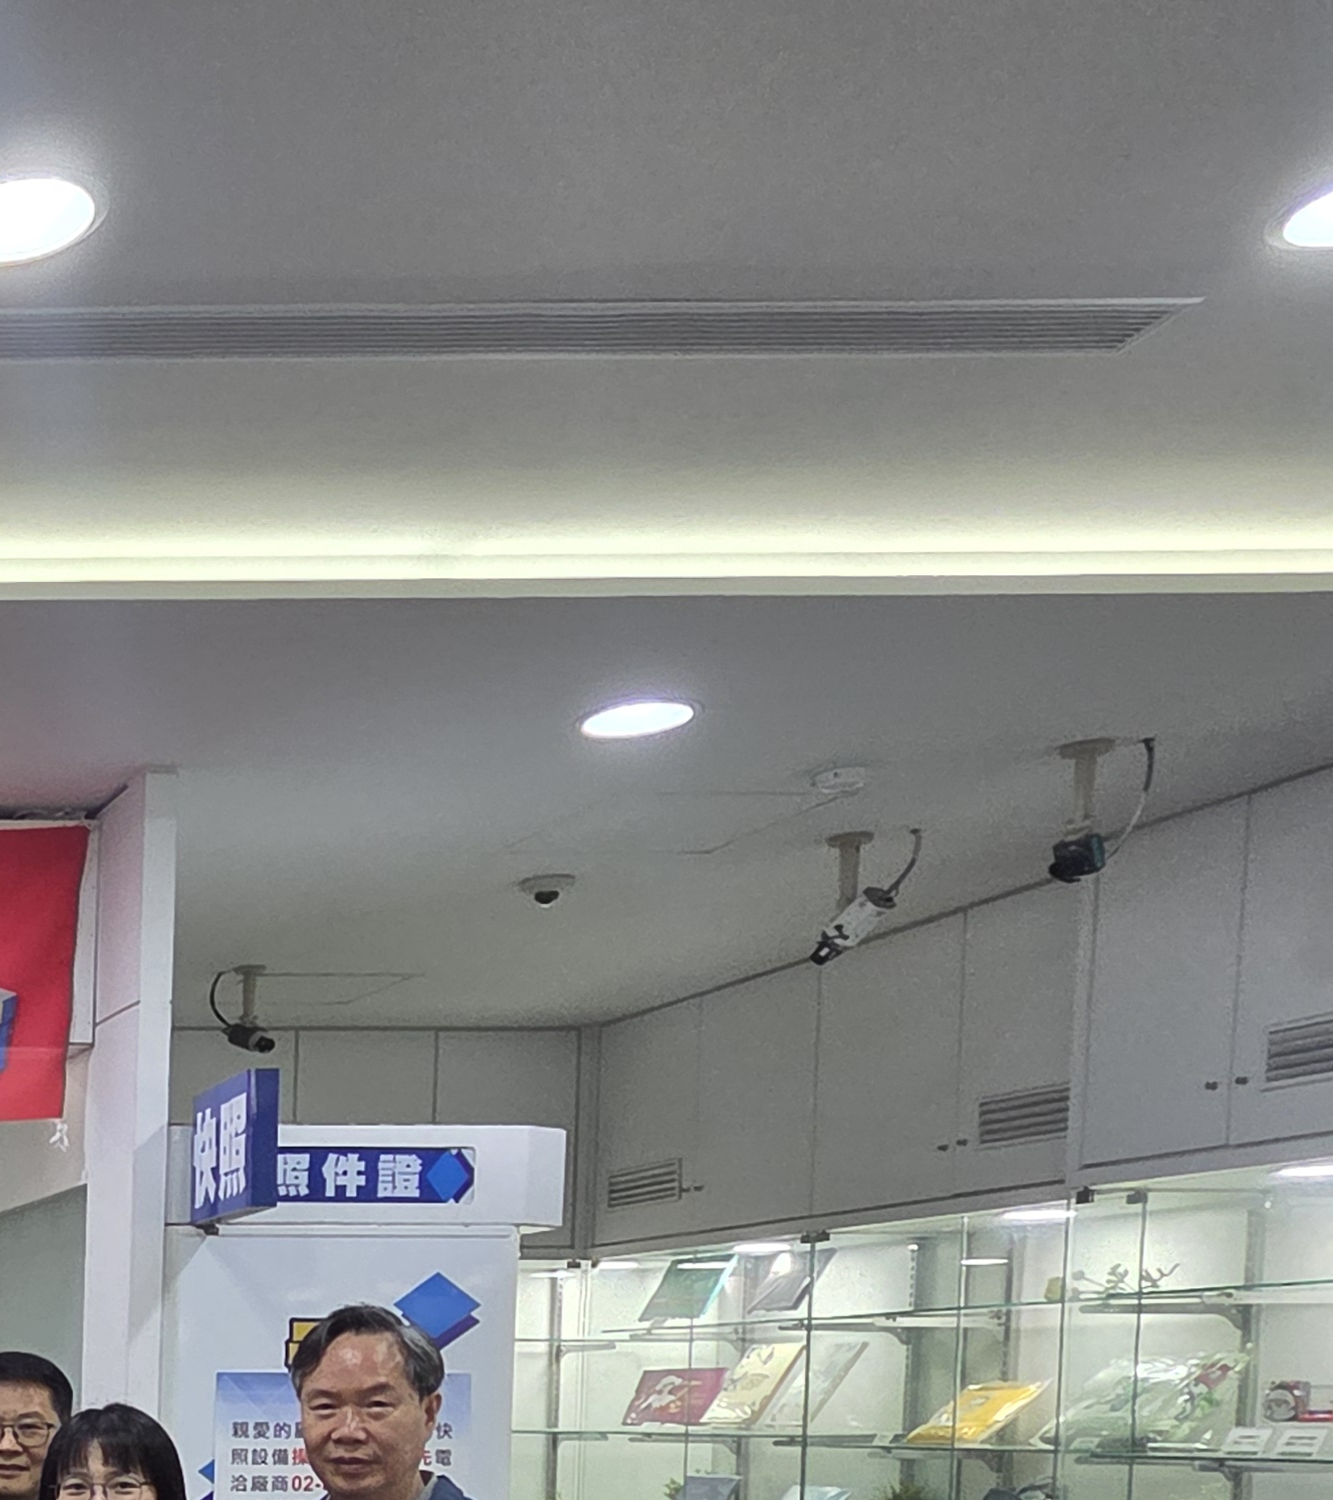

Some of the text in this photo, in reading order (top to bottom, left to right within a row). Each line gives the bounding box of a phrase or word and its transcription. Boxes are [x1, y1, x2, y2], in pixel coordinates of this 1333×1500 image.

[193, 1092, 247, 1209] 快照
[231, 1475, 327, 1492] 洽廠商02-
